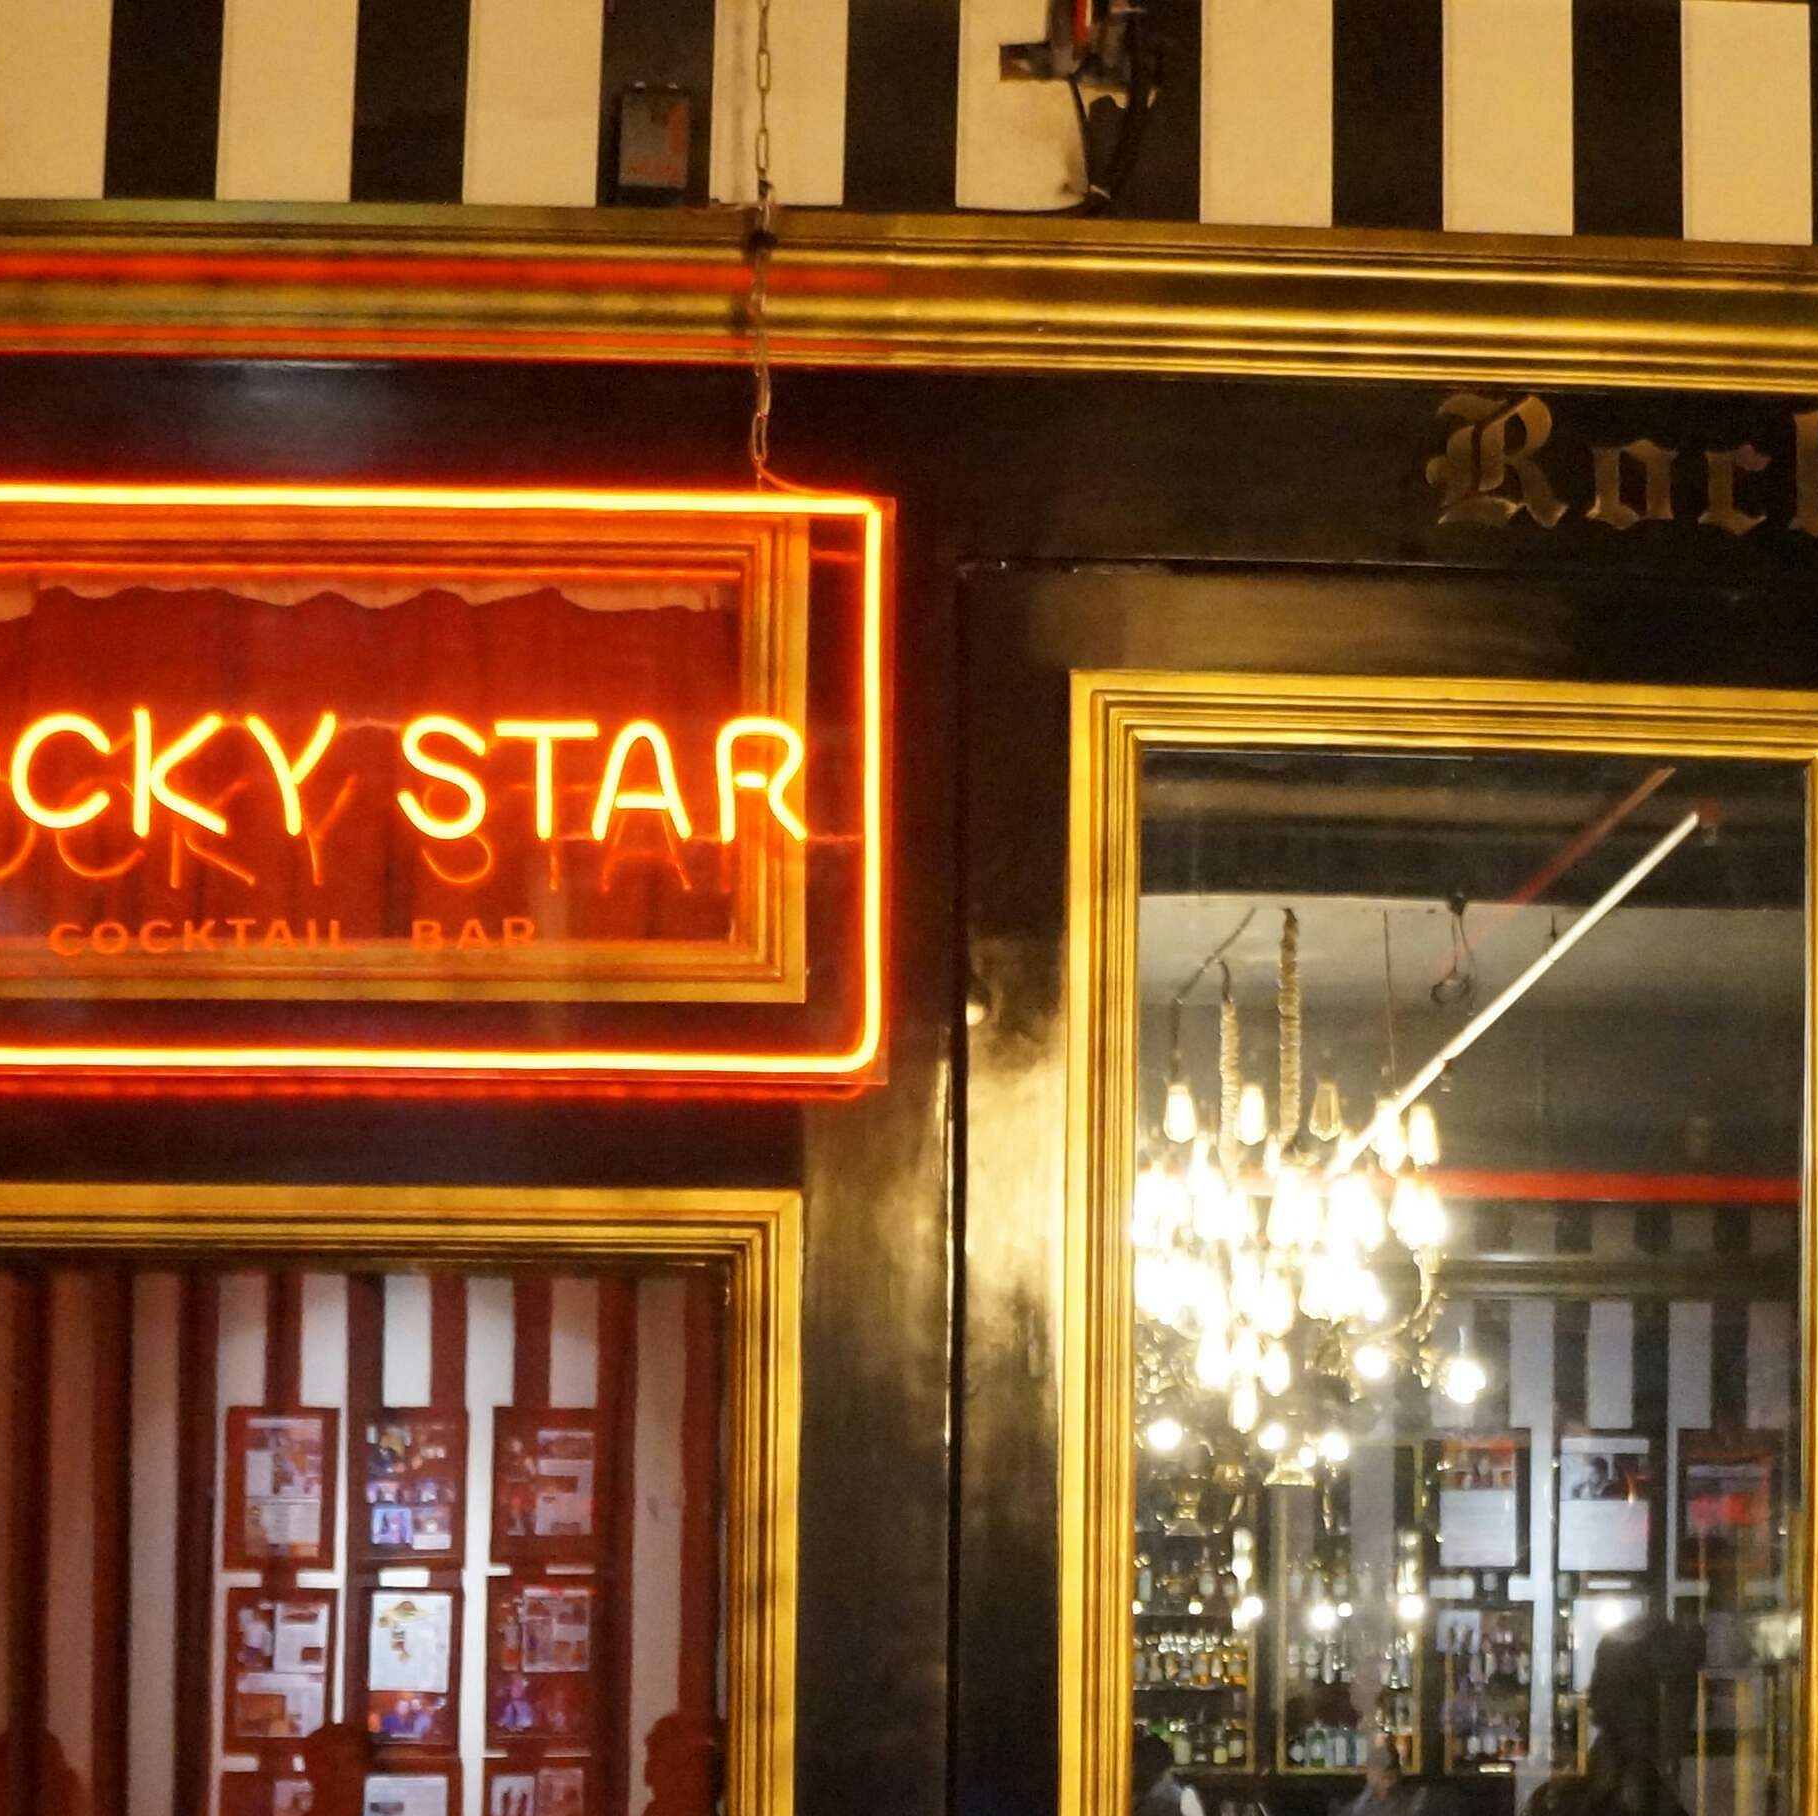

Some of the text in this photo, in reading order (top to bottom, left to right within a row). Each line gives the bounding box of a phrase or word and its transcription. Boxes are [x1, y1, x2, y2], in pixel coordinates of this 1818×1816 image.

[396, 713, 809, 845] STAR
[47, 916, 538, 957] COCKTAIL BAR
